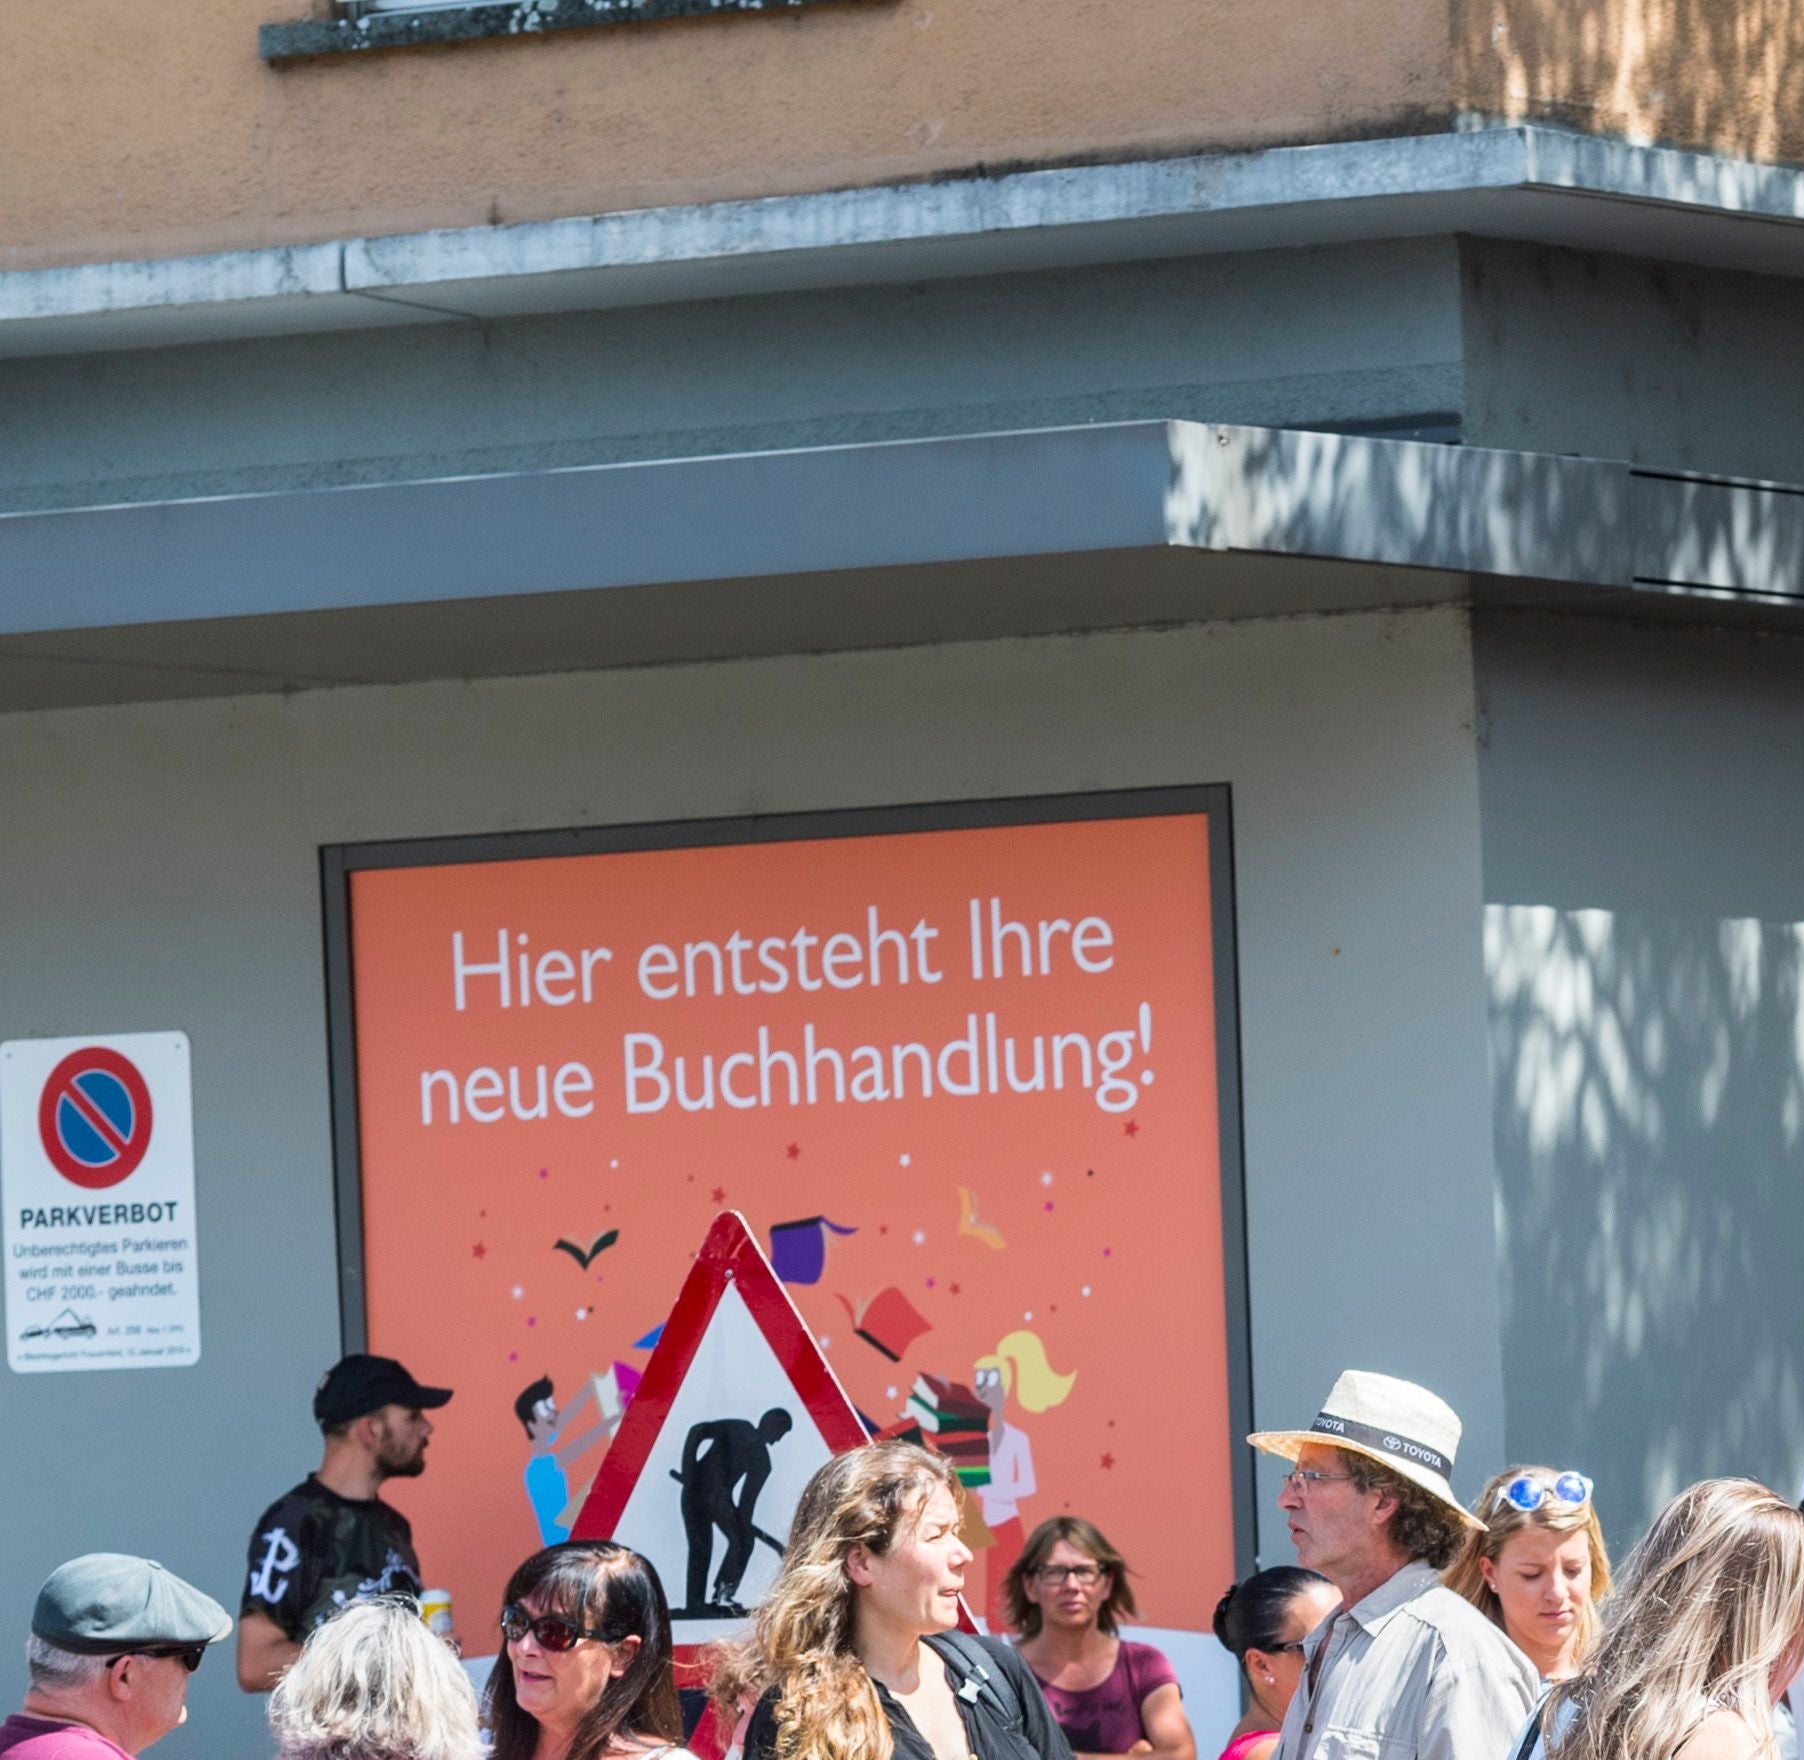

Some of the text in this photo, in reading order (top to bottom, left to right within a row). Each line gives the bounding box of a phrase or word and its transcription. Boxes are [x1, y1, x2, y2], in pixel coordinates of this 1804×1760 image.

[452, 897, 1115, 1010] Hier entsteht Ihre
[421, 1002, 1155, 1125] neue Buchhandlung!
[20, 1202, 178, 1229] PARKVERBOT
[13, 1237, 188, 1258] Unberechtigtes Parkieren
[19, 1259, 183, 1280] wird mit einer Busse bis
[25, 1286, 55, 1302] CHF
[1316, 1416, 1345, 1434] OYOTA
[1403, 1441, 1442, 1469] TOYOTA
